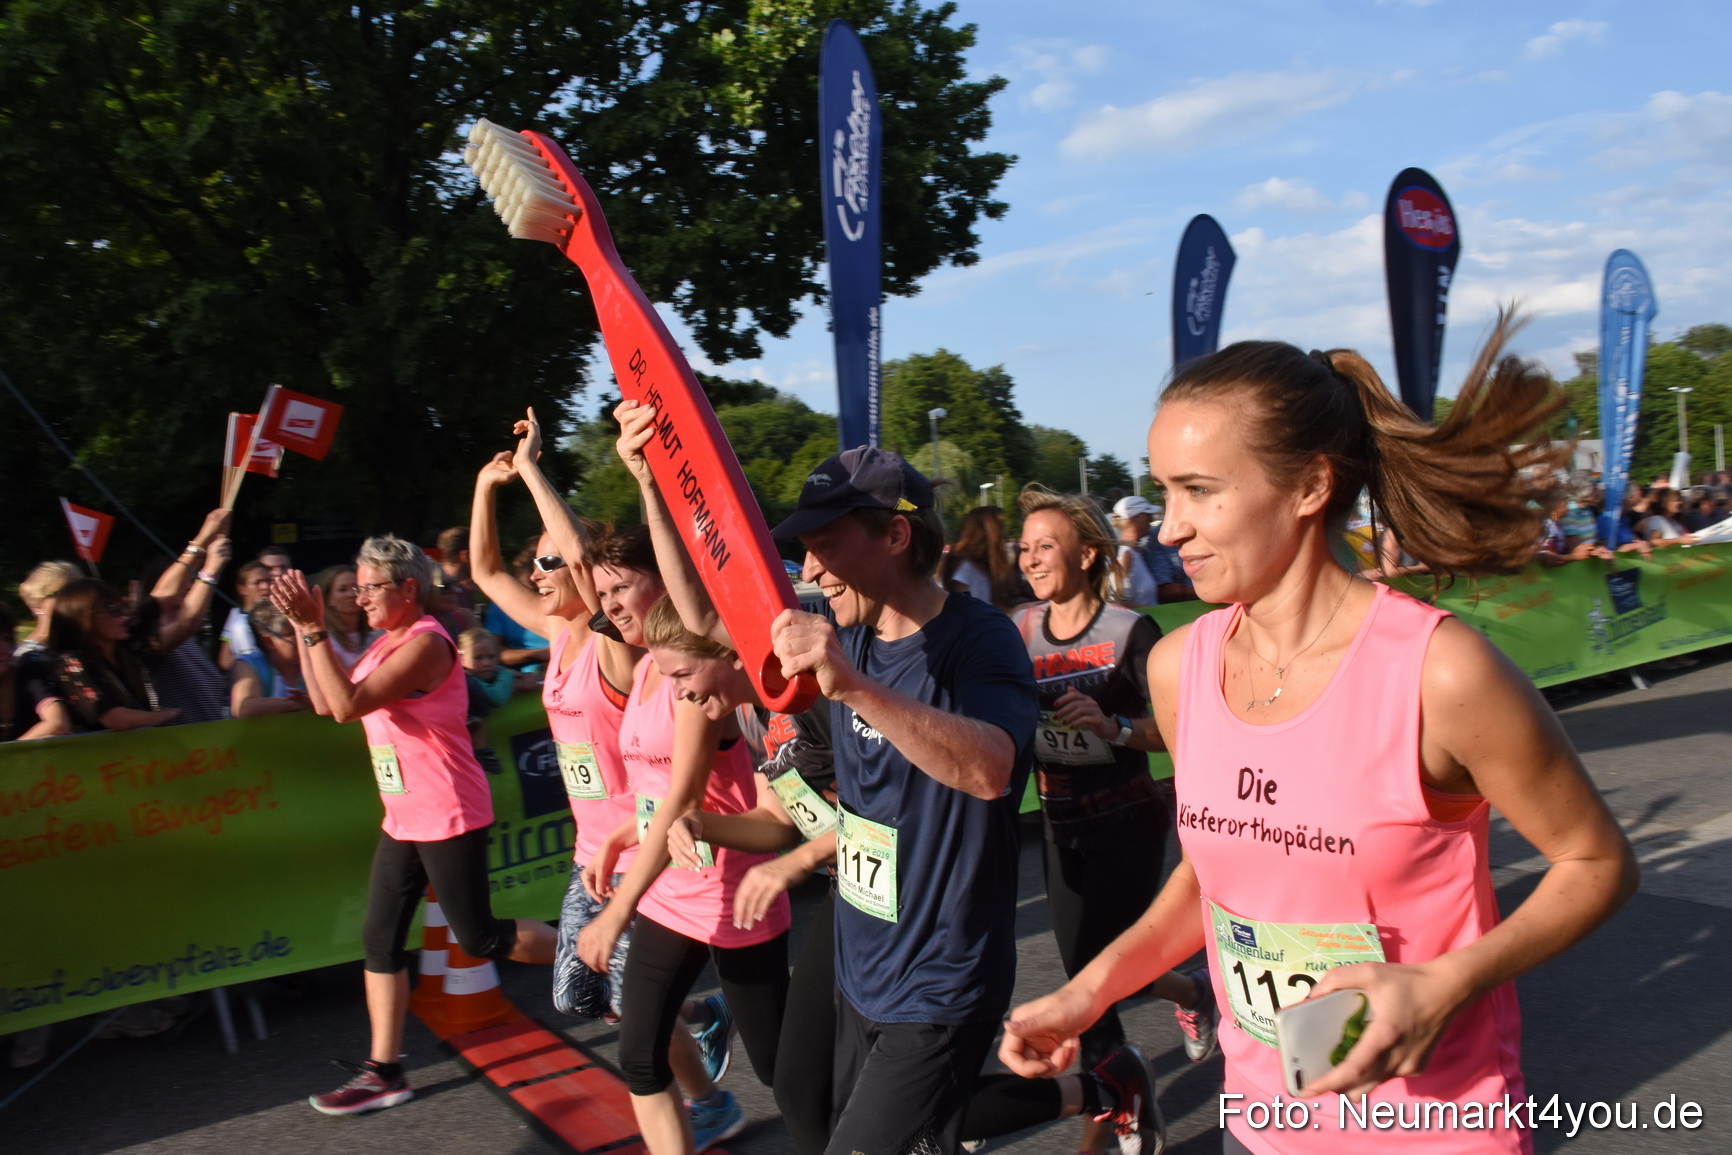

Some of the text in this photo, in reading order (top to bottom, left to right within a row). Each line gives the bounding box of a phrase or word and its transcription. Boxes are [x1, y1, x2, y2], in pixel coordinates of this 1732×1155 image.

[628, 348, 731, 572] DR. HELMUT HOFMANN
[1033, 640, 1116, 680] HAARE
[1042, 729, 1090, 751] 974
[97, 747, 241, 795] Firmen
[1237, 766, 1278, 806] Die
[1178, 802, 1356, 857] Kieferorthopäden
[857, 884, 885, 903] Michael
